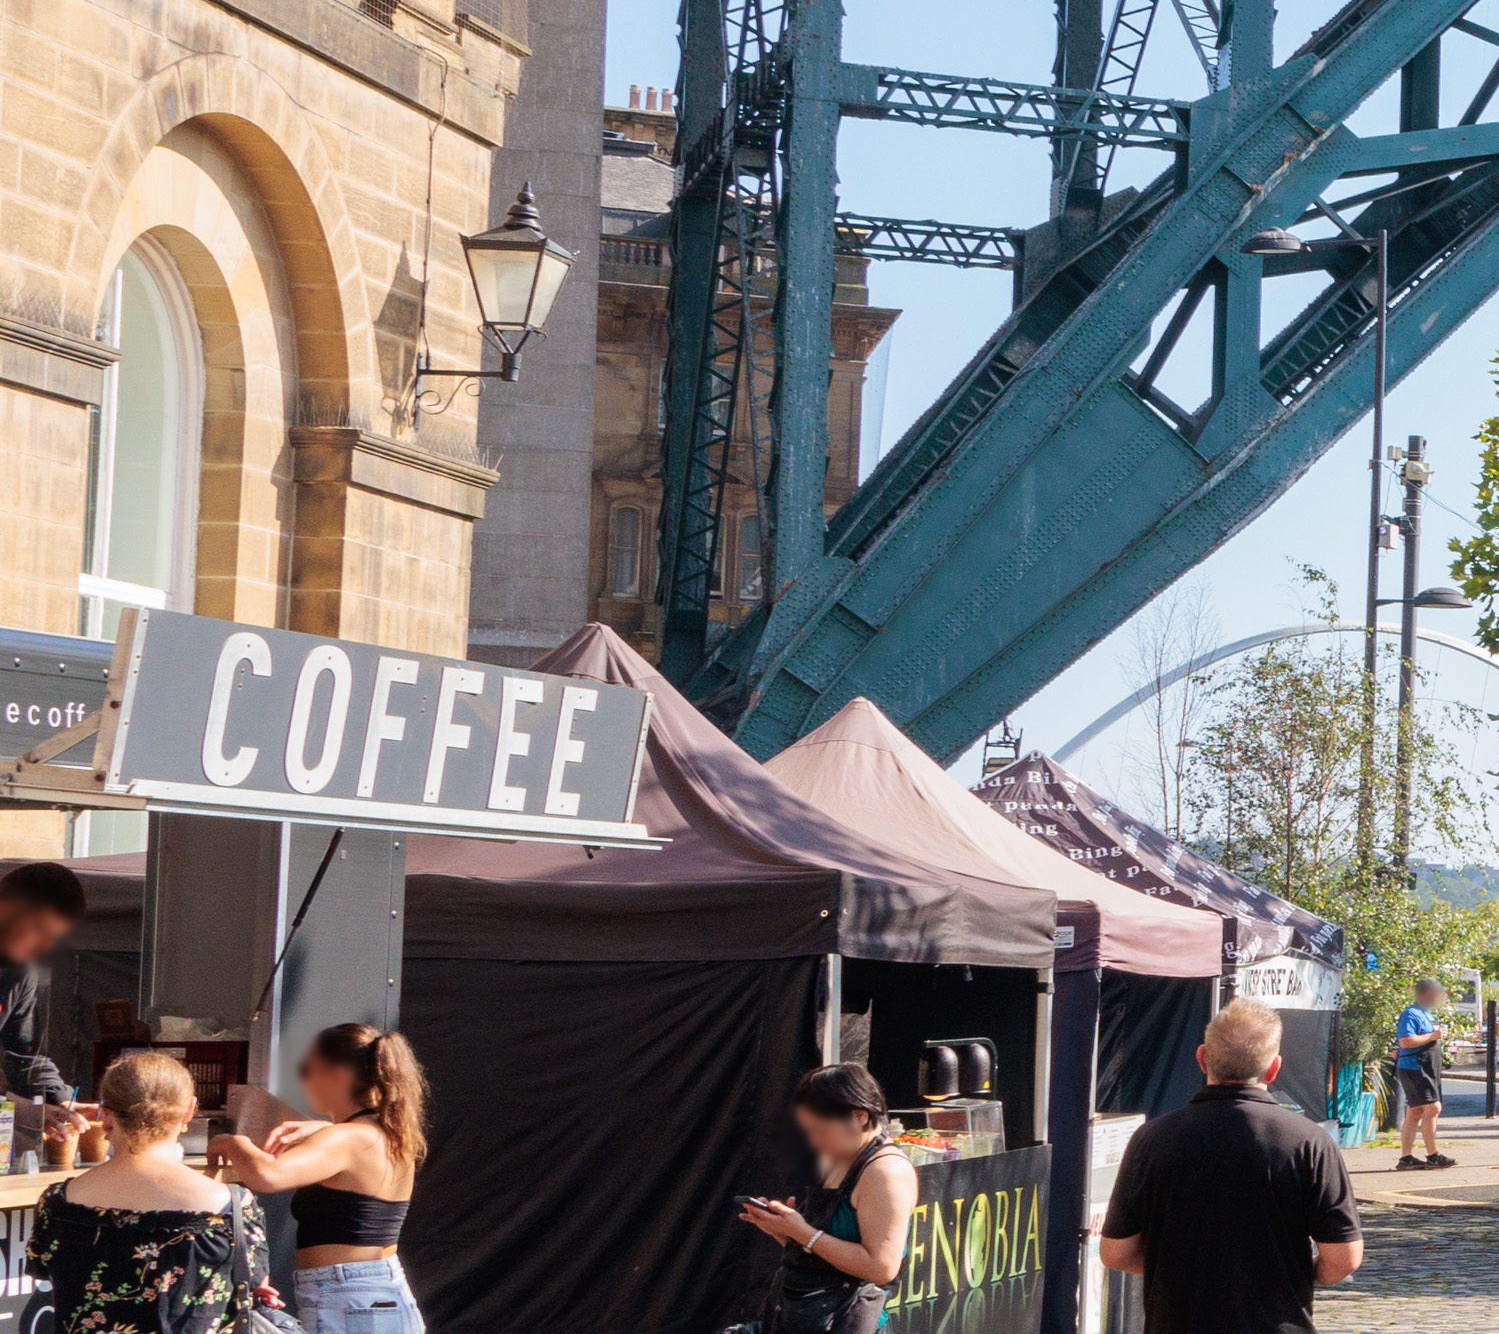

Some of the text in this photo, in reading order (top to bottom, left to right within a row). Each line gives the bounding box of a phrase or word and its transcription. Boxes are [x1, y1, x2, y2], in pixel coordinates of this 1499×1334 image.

[202, 632, 598, 816] COFFEE
[1019, 822, 1059, 836] ing
[1068, 845, 1123, 861] Bing
